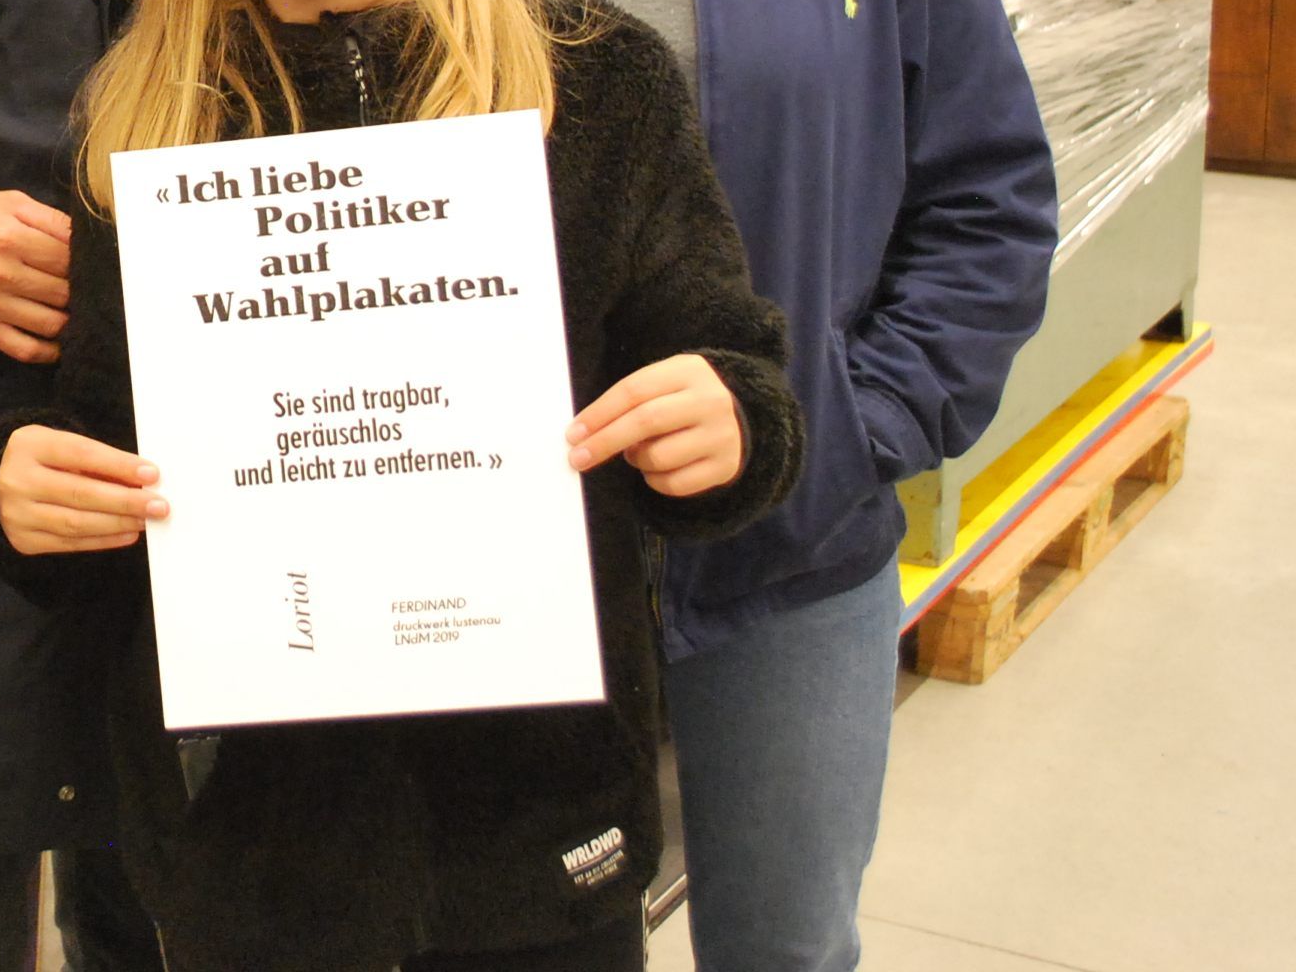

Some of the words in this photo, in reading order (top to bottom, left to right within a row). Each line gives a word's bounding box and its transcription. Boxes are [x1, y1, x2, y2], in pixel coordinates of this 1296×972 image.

[250, 161, 363, 197] liebe
[255, 195, 450, 237] Politiker
[260, 241, 331, 278] auf
[192, 275, 519, 324] Wahlplakaten.
[272, 392, 305, 418] Sie
[312, 386, 356, 414] sind
[362, 381, 450, 414] tragbar,
[276, 417, 403, 457] geräuschlos
[234, 459, 273, 487] und
[280, 455, 337, 483] leicht
[343, 458, 367, 478] zu
[374, 448, 483, 476] entfernen.
[285, 571, 315, 652] Loriot
[391, 597, 467, 614] FERDINAND
[393, 617, 450, 632] druckwerk
[452, 616, 501, 628] lustenau
[395, 633, 430, 646] LNdM
[433, 630, 460, 643] 2019
[562, 827, 622, 871] WRLDWD
